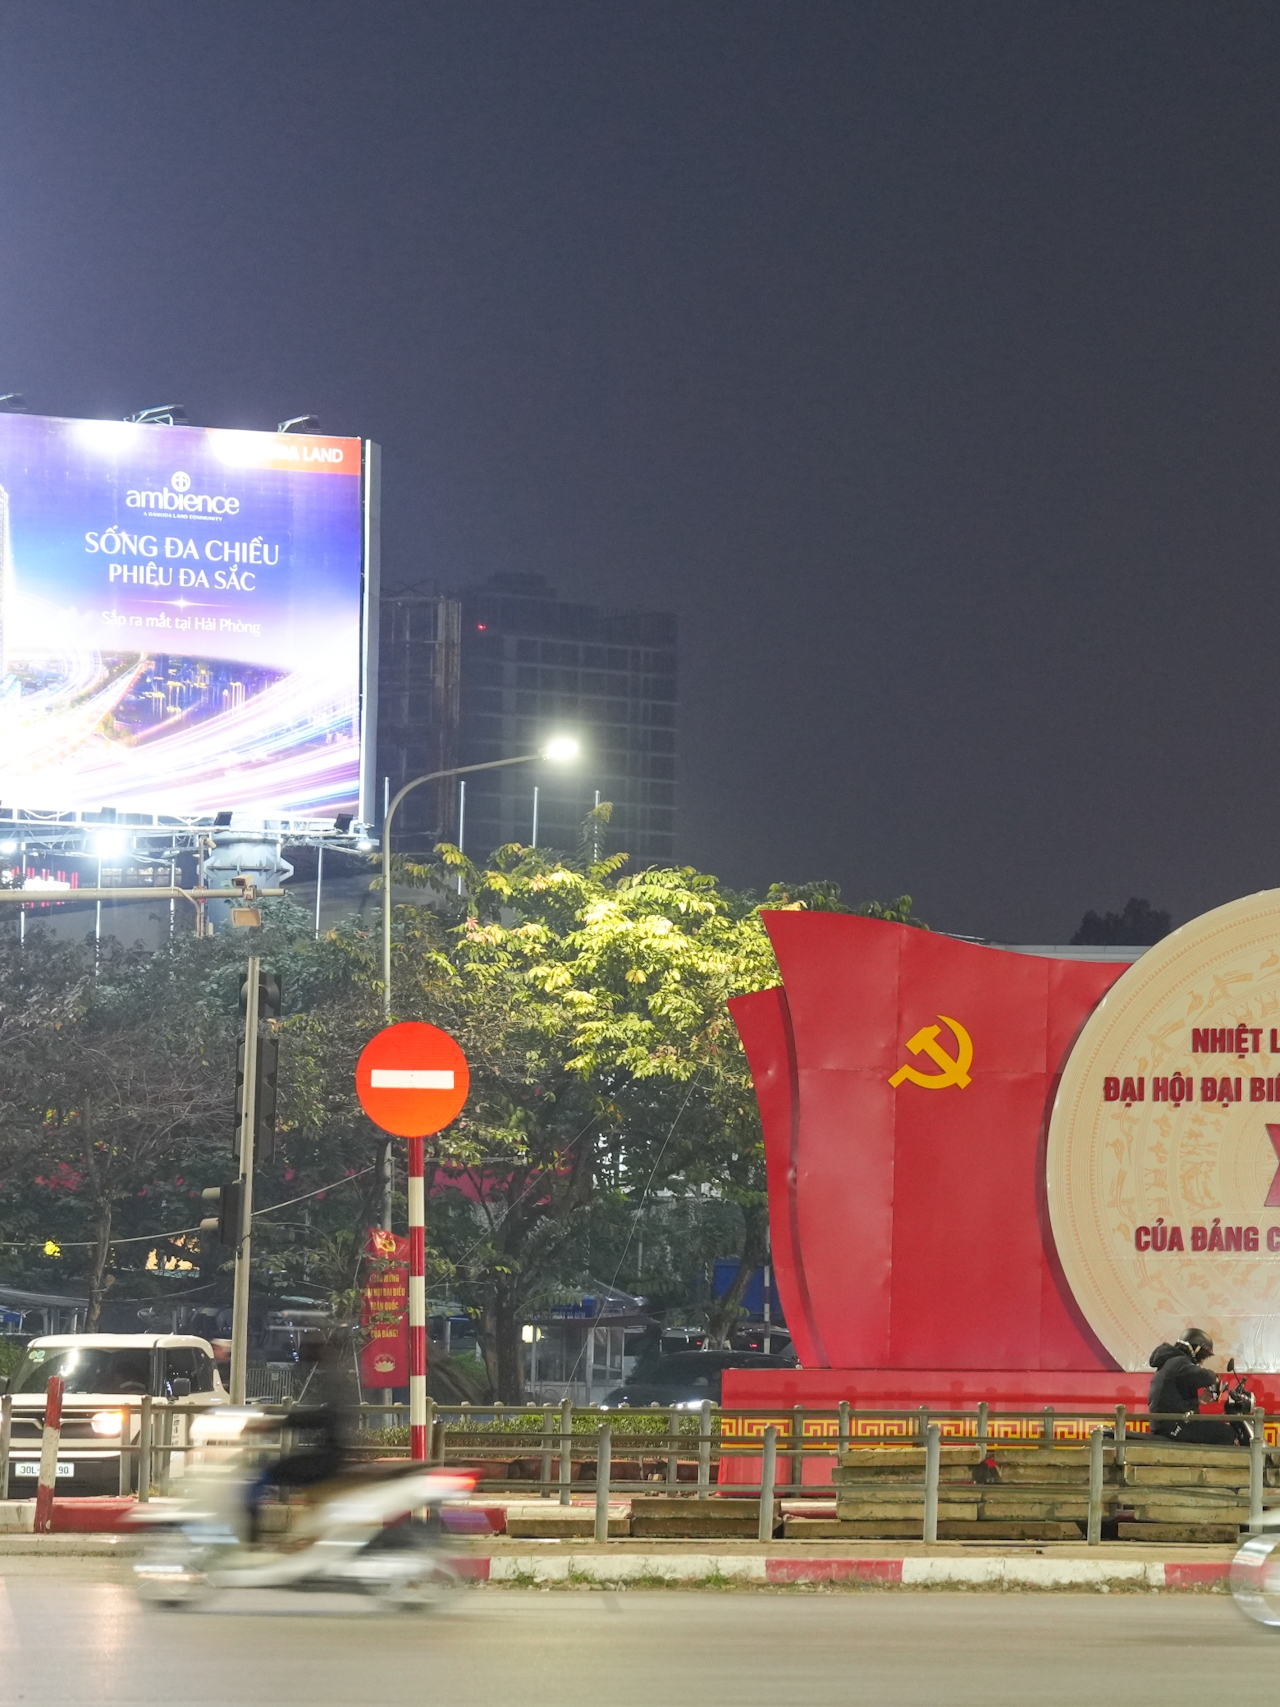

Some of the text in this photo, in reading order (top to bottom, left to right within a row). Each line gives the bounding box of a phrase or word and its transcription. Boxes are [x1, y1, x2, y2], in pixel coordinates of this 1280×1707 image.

[303, 446, 344, 463] LAND
[125, 486, 240, 515] ambience
[85, 525, 279, 565] SỐNG ĐA CHIỀU
[109, 561, 256, 591] PHIÊU ĐA SẮC
[102, 609, 261, 637] Sắp ra mắt tại Hải Phòng
[1191, 1023, 1263, 1059] NHIỆT
[1103, 1076, 1145, 1108] ĐẠI
[1152, 1071, 1194, 1108] HỘI
[1200, 1076, 1242, 1108] ĐẠI
[1135, 1217, 1185, 1252] CỦA
[1191, 1217, 1260, 1252] ĐẢNG
[20, 1465, 69, 1475] 30L-.90
